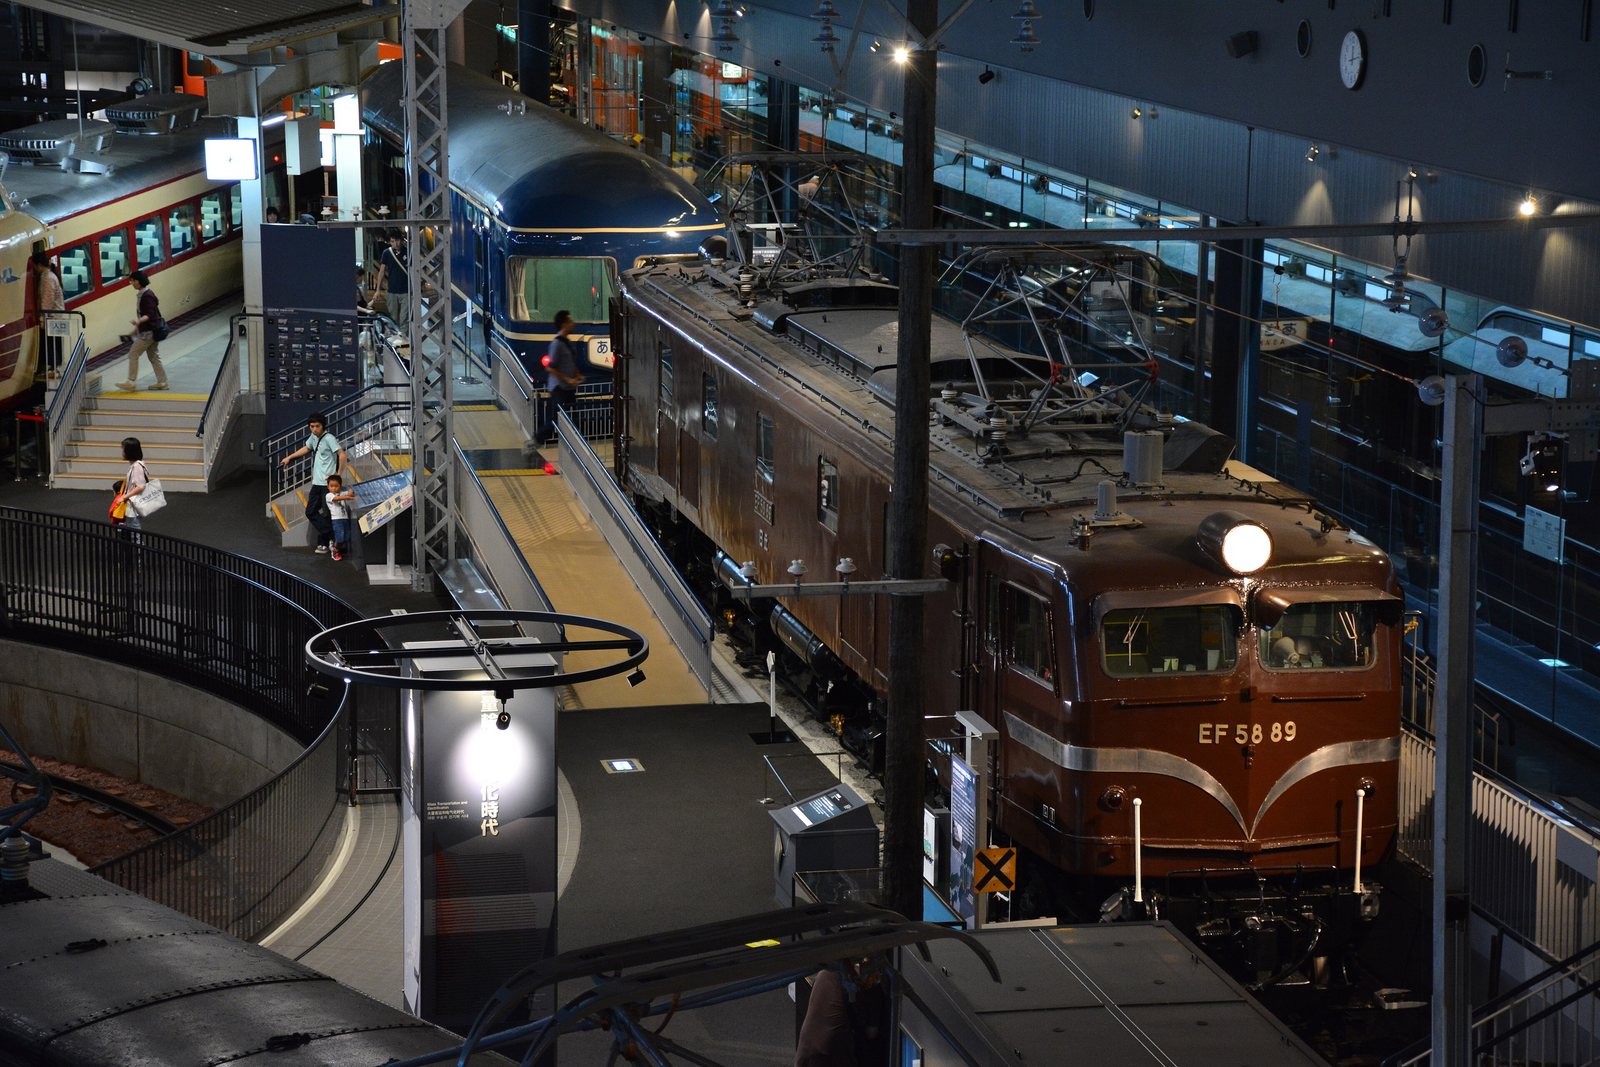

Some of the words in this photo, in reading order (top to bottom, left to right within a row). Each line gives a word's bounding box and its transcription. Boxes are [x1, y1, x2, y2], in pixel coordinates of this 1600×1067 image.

[597, 341, 608, 353] あ
[1199, 723, 1229, 744] EF
[1234, 723, 1263, 744] 58
[1270, 721, 1297, 742] 89
